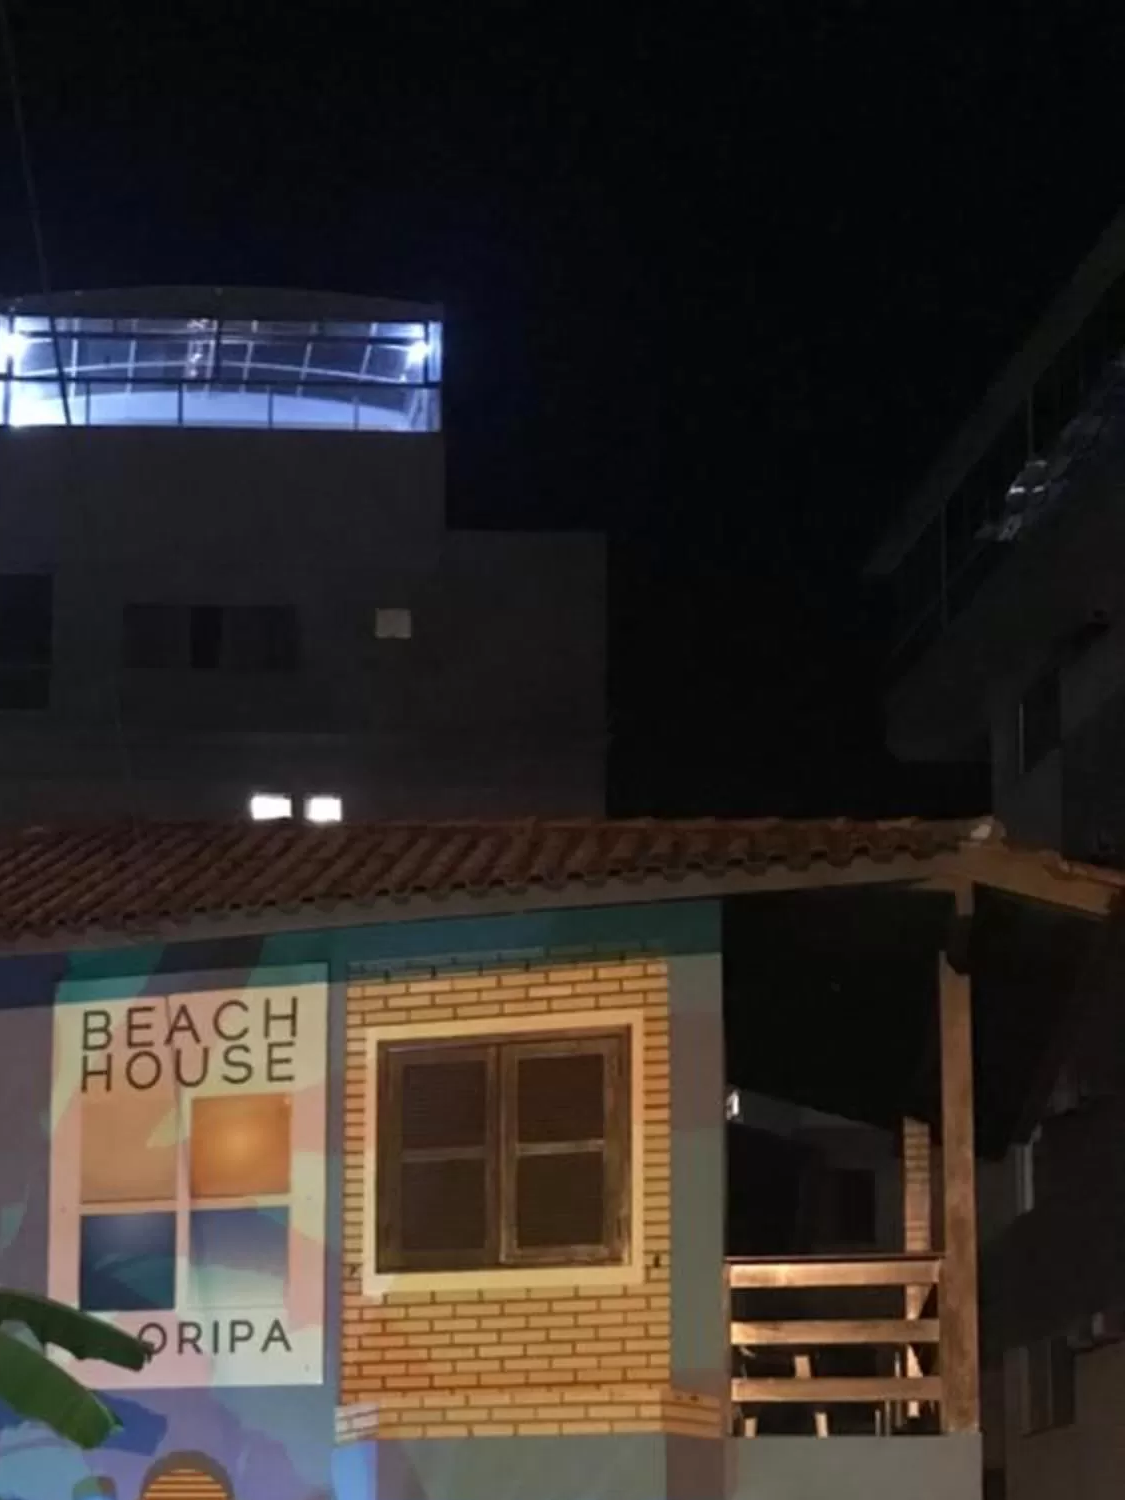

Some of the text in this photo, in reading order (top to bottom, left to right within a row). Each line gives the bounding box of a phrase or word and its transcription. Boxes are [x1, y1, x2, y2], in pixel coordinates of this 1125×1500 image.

[81, 996, 299, 1051] BEACH
[80, 1041, 296, 1093] HOUSE
[137, 1318, 294, 1356] ORIPA
